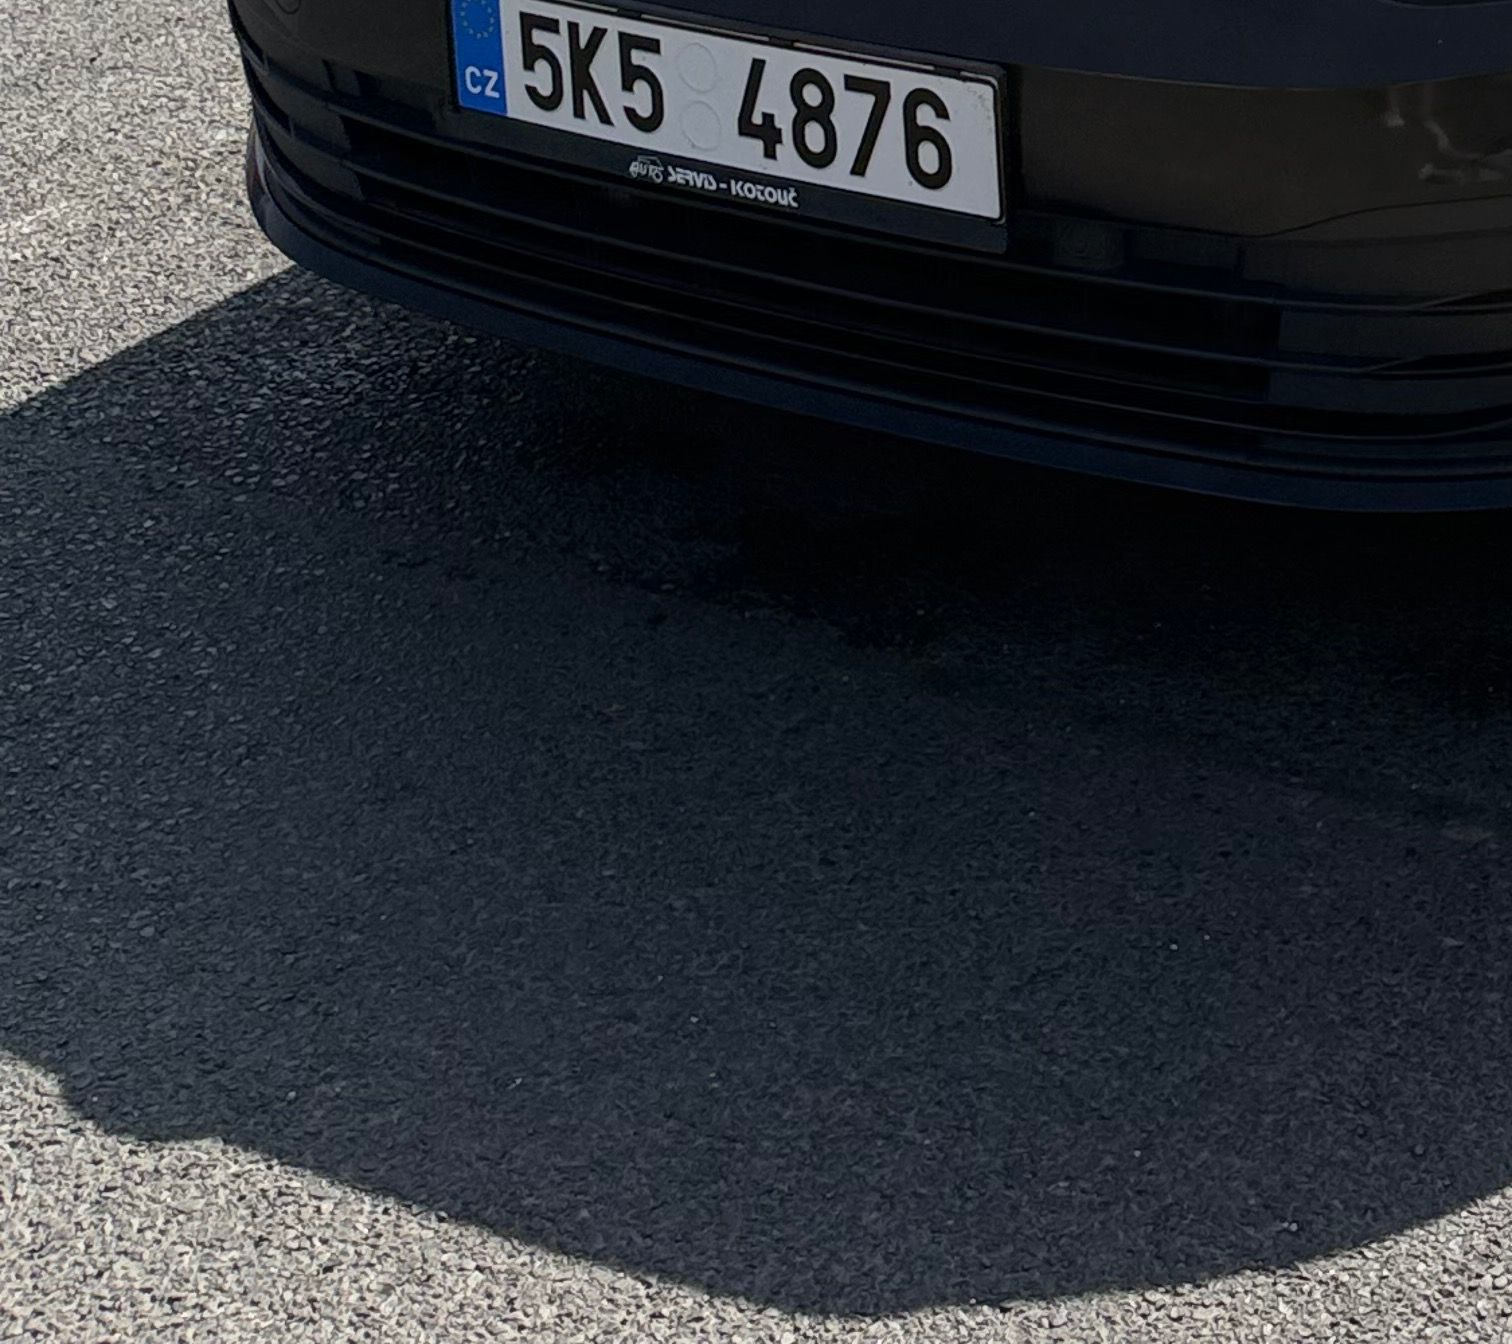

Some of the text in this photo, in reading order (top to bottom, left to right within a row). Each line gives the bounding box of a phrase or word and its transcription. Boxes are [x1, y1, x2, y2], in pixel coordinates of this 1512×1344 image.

[464, 66, 500, 98] CZ
[519, 11, 952, 190] 5K5 4876
